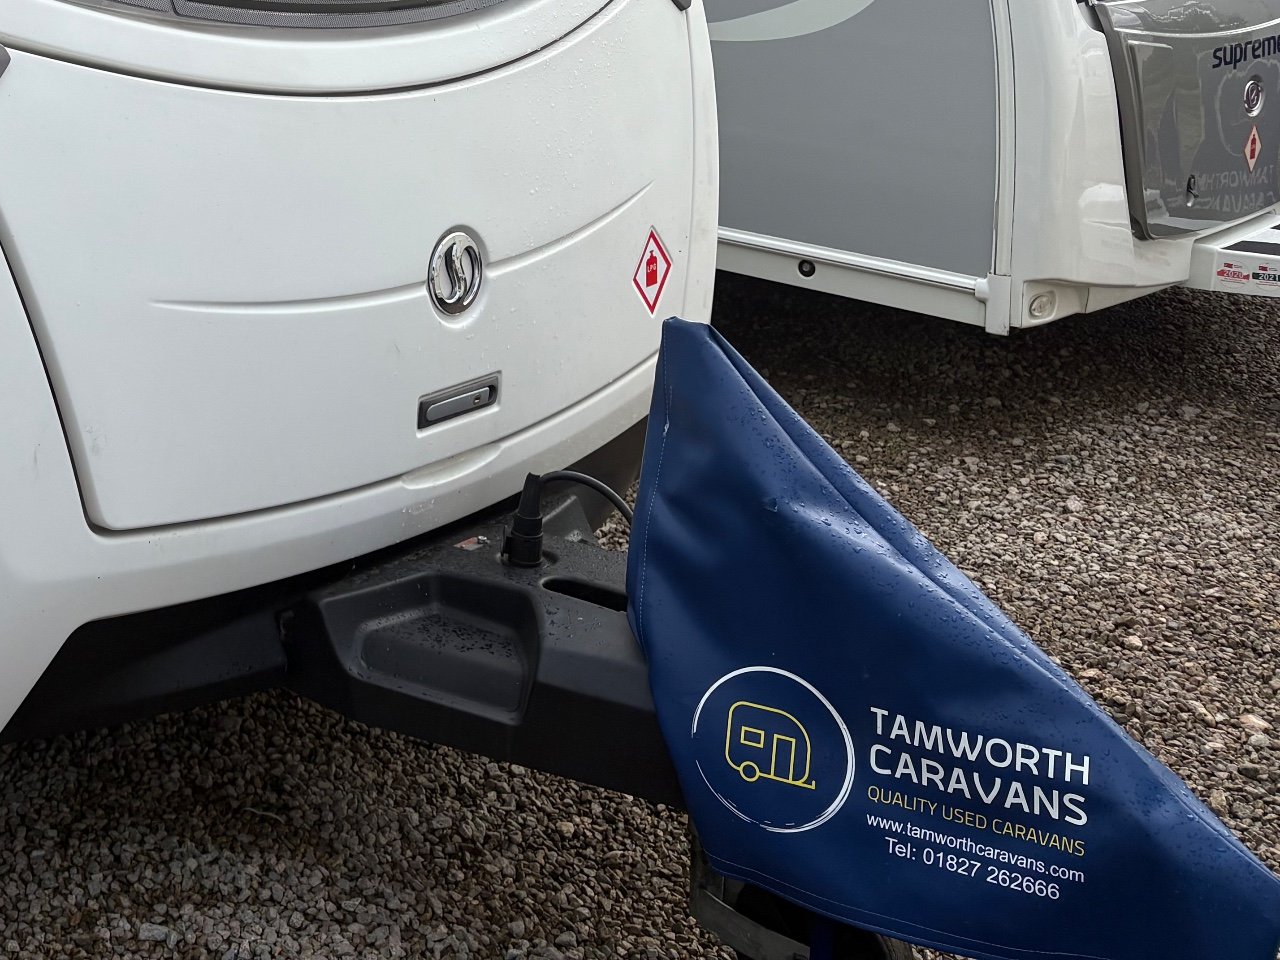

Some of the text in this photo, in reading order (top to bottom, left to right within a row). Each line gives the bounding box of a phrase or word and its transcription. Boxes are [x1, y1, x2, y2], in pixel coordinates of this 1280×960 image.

[647, 263, 657, 273] LPG
[1223, 270, 1244, 279] 2020
[1258, 273, 1279, 282] 2021
[870, 706, 1090, 785] TAMWORTH
[869, 743, 1088, 826] CARAVANS
[866, 813, 1085, 882] www.tamworthcaravans.com
[867, 785, 1085, 857] QUALITY USED CARAVANS
[885, 836, 1060, 900] Tel: 01827 262666
